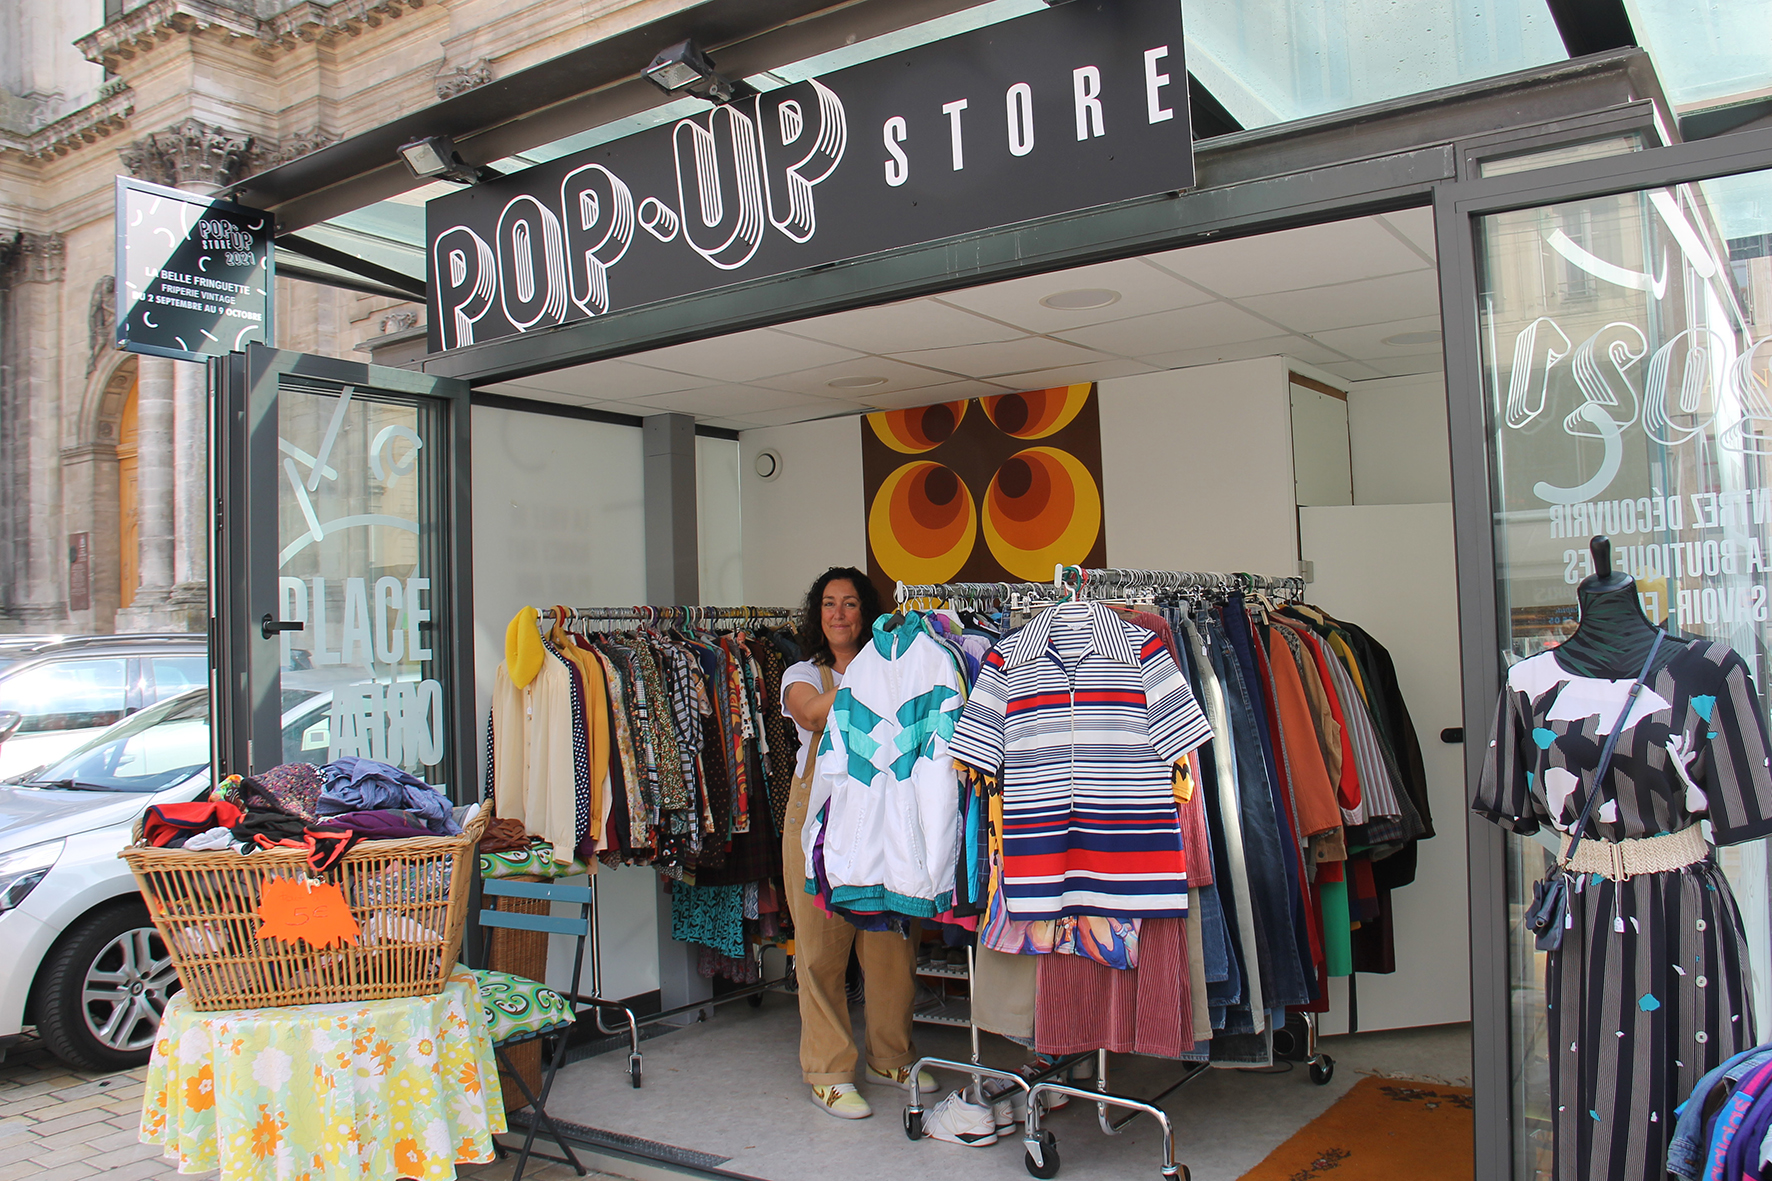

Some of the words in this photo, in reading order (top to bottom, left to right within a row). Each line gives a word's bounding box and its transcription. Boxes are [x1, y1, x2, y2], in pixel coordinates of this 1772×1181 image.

[883, 44, 1174, 187] STORE
[202, 239, 232, 250] STORE
[225, 251, 256, 266] 2021
[145, 266, 159, 278] LA
[160, 269, 193, 285] BELLE
[193, 275, 251, 296] FRINGUETTE
[161, 283, 200, 298] FRIPERIE
[200, 290, 236, 305] VINTAGE
[132, 290, 146, 301] DU
[147, 293, 155, 303] 2
[155, 294, 203, 311] SEPTEMBRE
[203, 304, 217, 314] AU
[218, 307, 225, 315] 9
[225, 307, 263, 322] OCTOBRE
[279, 576, 433, 667] PLACE
